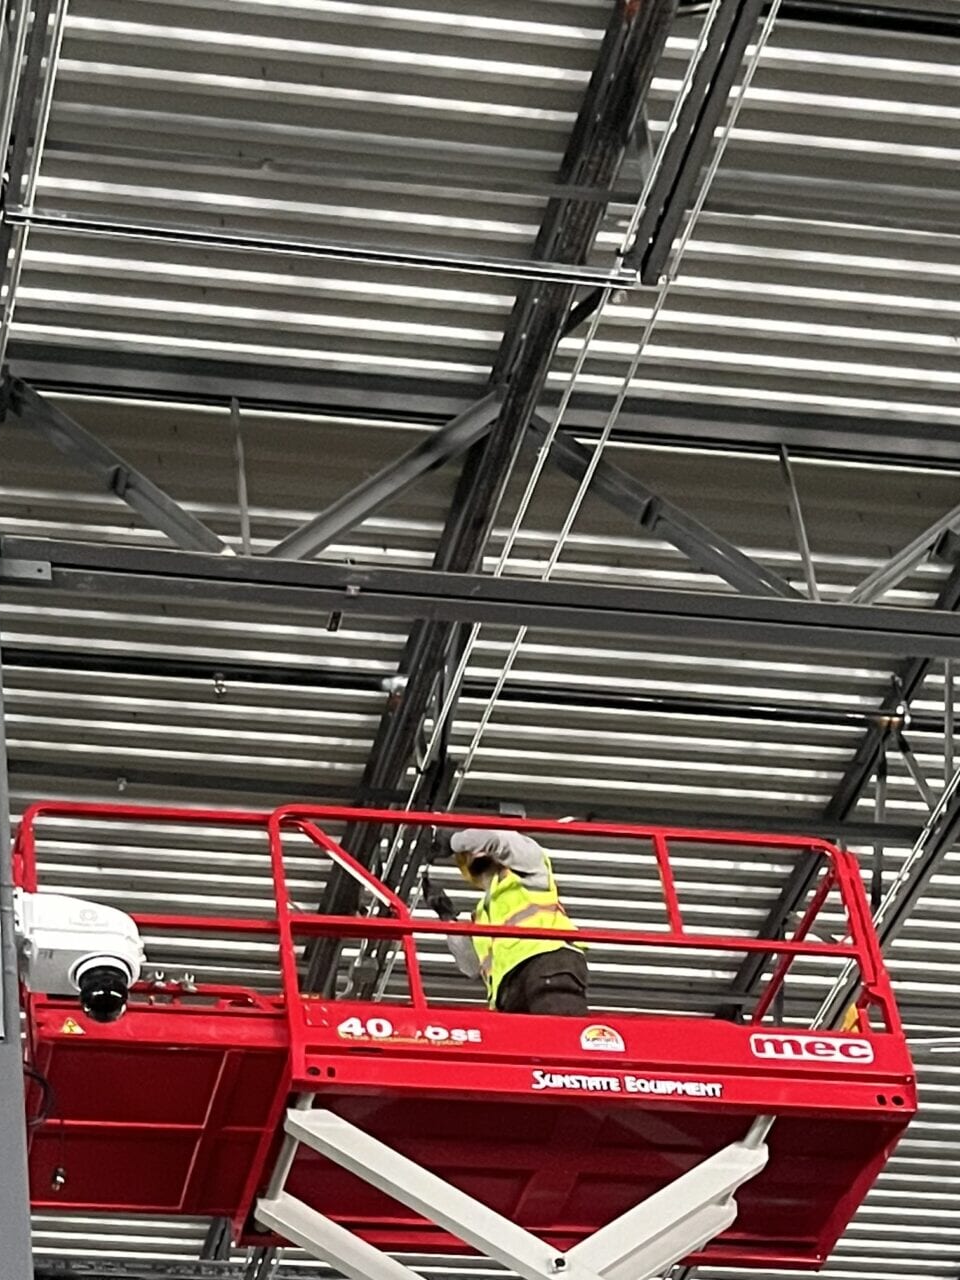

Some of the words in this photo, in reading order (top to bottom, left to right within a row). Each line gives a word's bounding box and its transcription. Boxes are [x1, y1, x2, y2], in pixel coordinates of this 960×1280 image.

[753, 1038, 871, 1059] mec
[531, 1070, 621, 1092] SUNSTATE
[624, 1075, 723, 1098] EQUIPMENT
